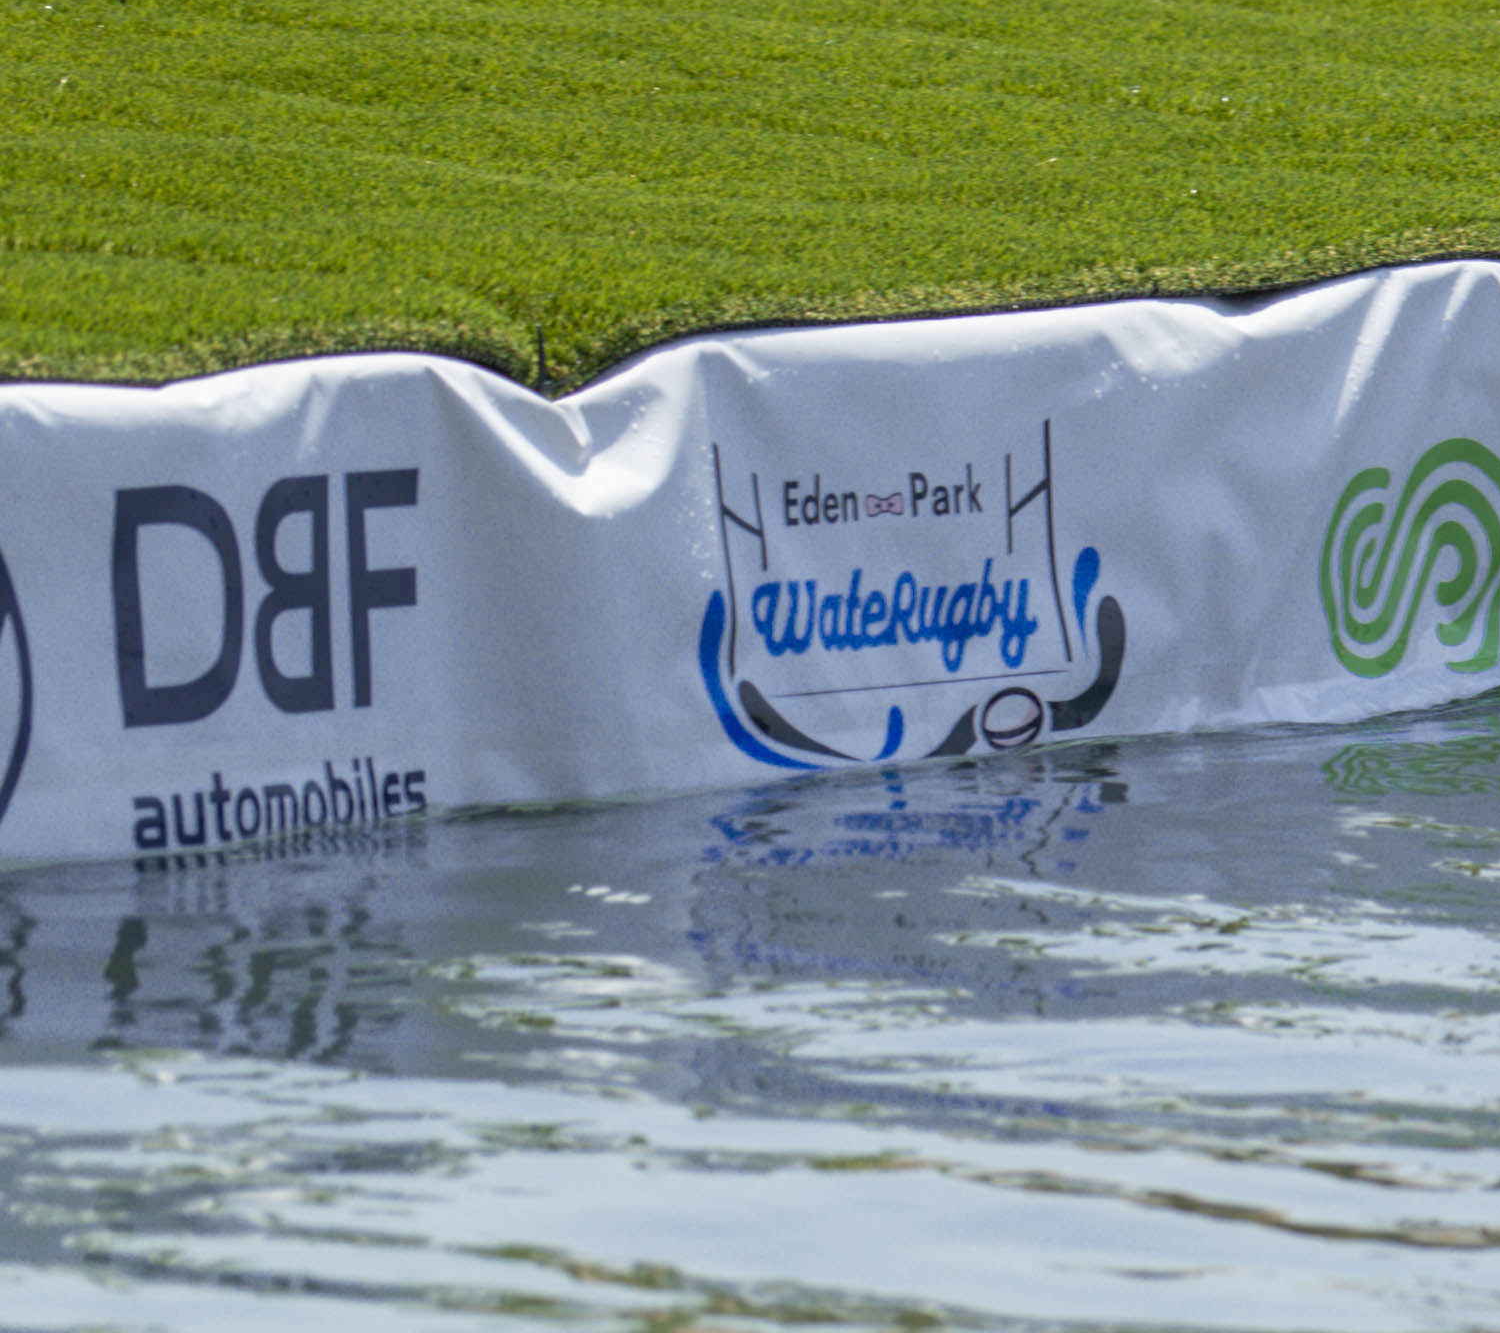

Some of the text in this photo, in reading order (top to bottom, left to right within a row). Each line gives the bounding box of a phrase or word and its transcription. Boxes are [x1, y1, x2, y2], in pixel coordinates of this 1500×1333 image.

[783, 464, 984, 526] Eden Park
[111, 467, 418, 728] DBF
[751, 557, 1038, 673] WateRugby
[133, 756, 427, 849] automobiles
